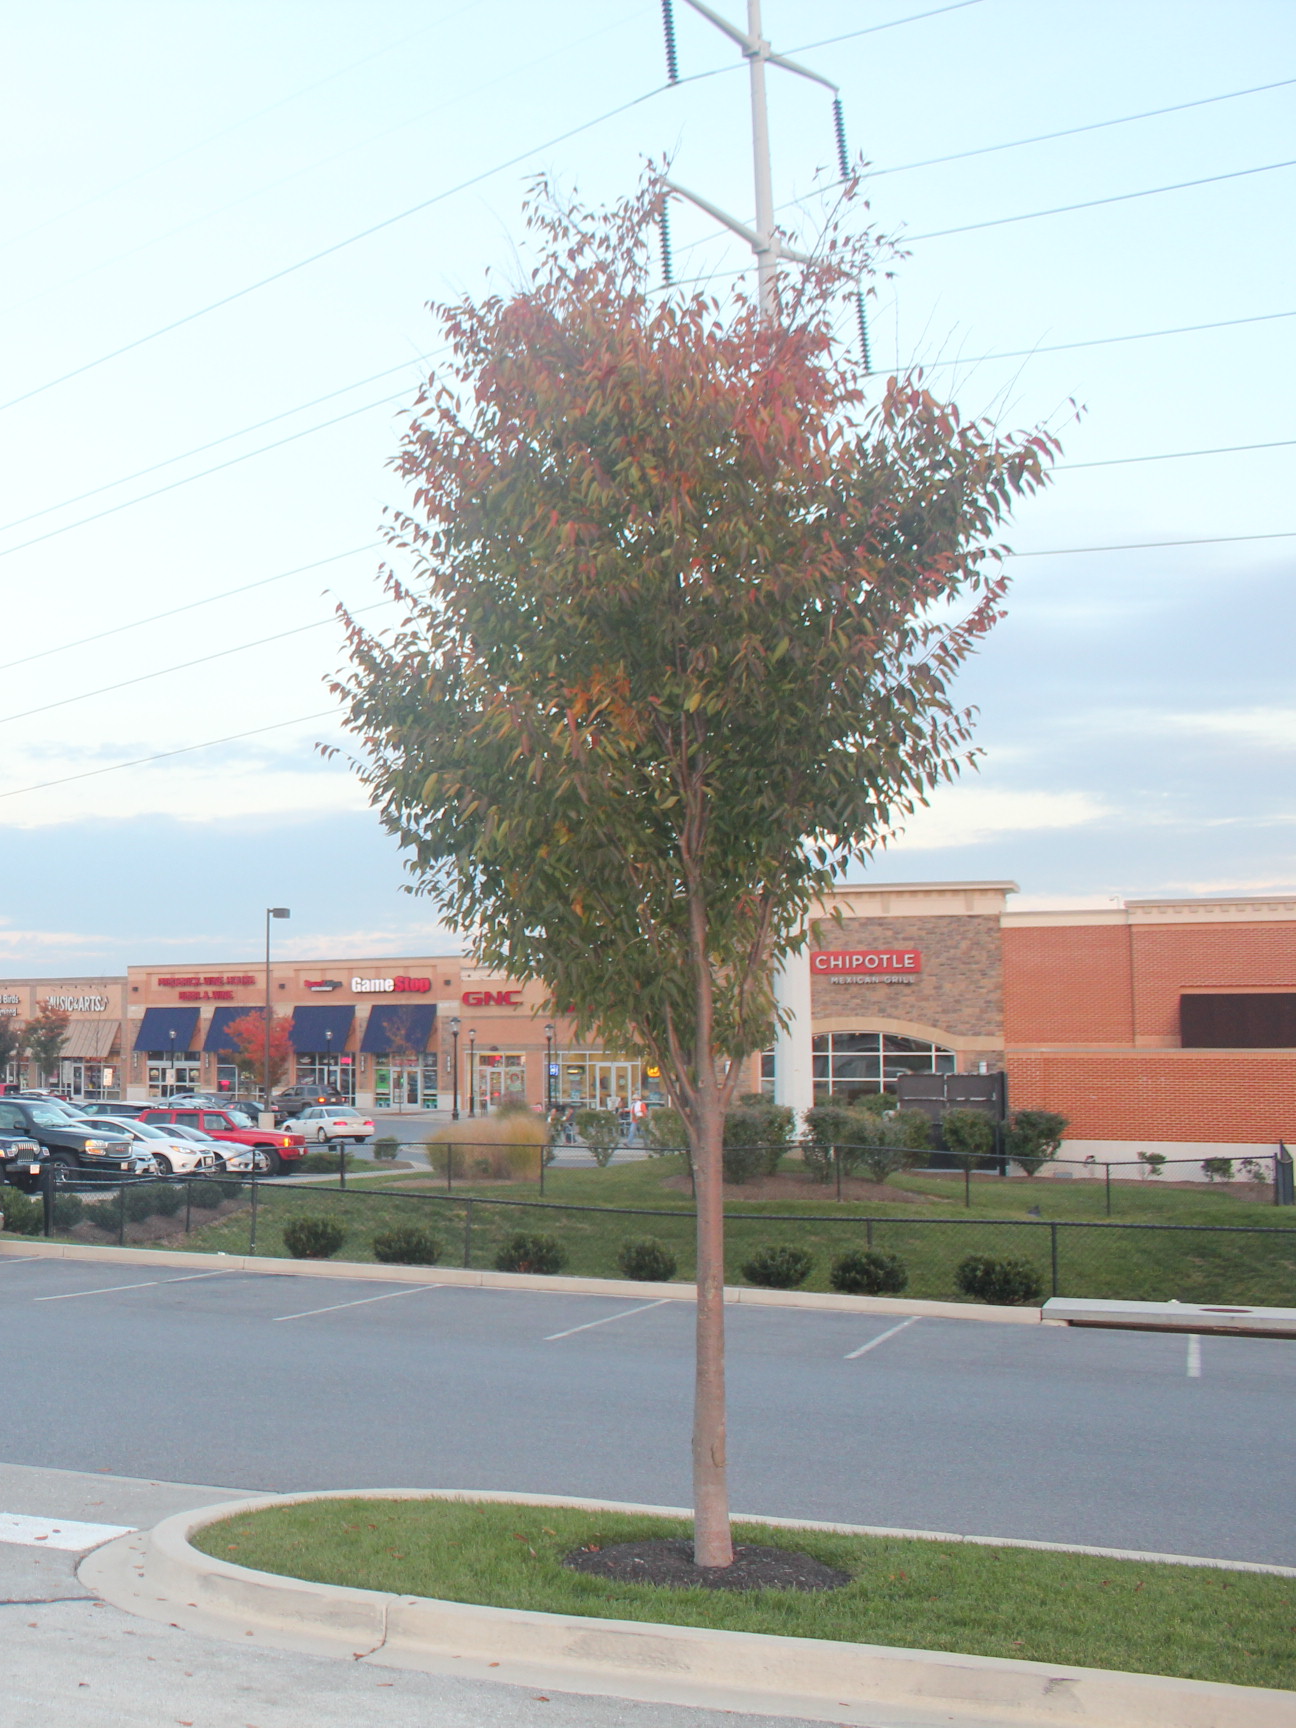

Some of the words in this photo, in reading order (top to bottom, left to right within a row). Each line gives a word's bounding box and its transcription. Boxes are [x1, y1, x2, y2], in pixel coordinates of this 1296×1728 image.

[815, 954, 916, 969] CHIPOTLE
[351, 976, 432, 993] GameStop
[830, 976, 879, 985] MEXICAN
[884, 975, 915, 984] GRILL
[3, 994, 19, 1004] Birds
[462, 990, 523, 1006] GNC
